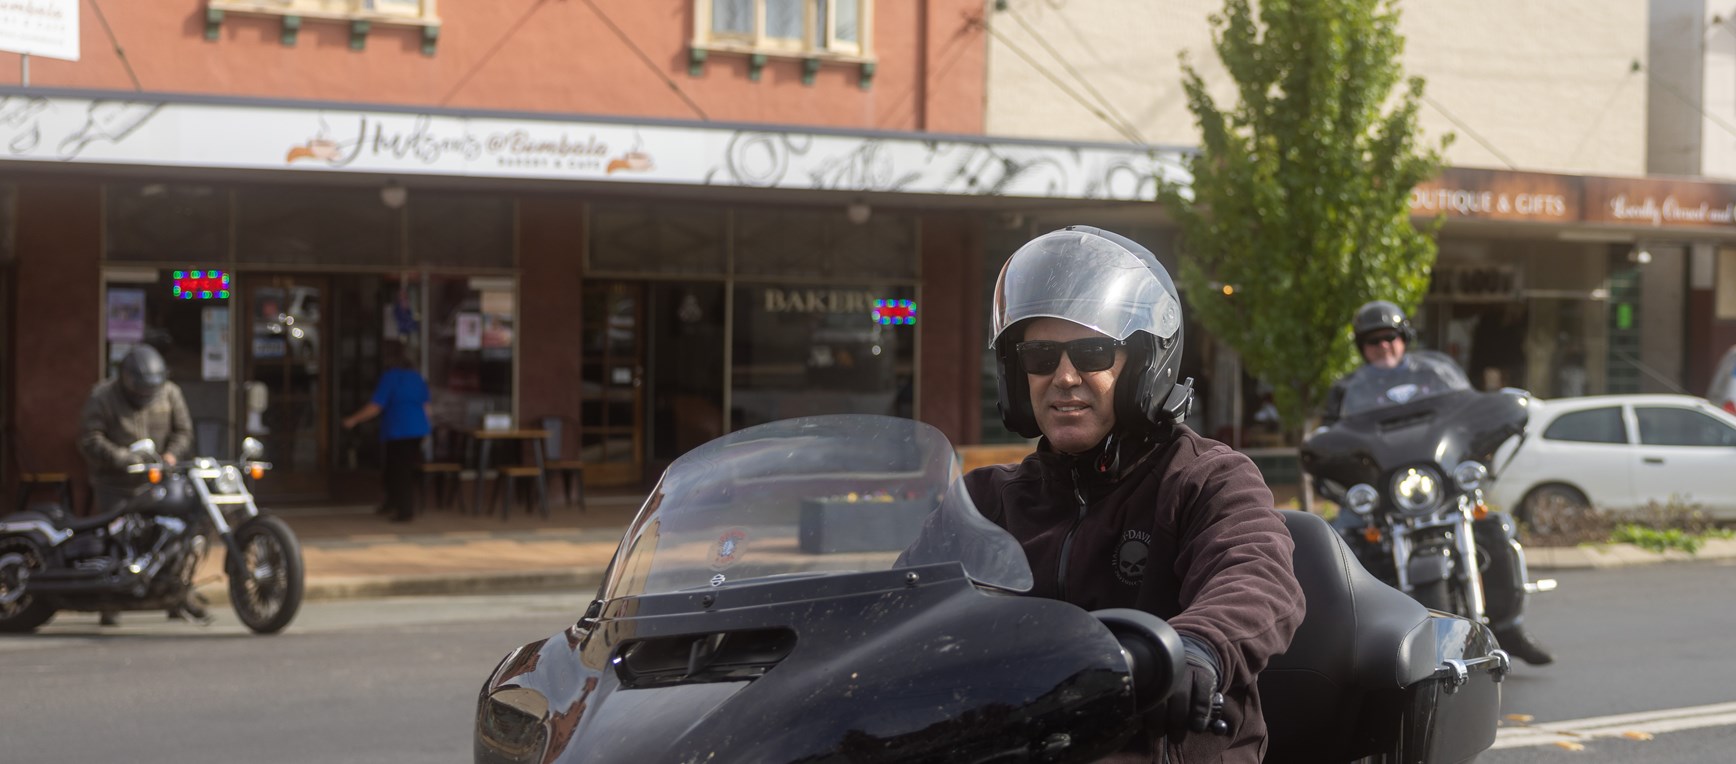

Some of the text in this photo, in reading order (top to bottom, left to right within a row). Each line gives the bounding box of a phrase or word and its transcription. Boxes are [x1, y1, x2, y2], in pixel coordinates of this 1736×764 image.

[1407, 186, 1566, 216] OUTIQUE & GIFTS
